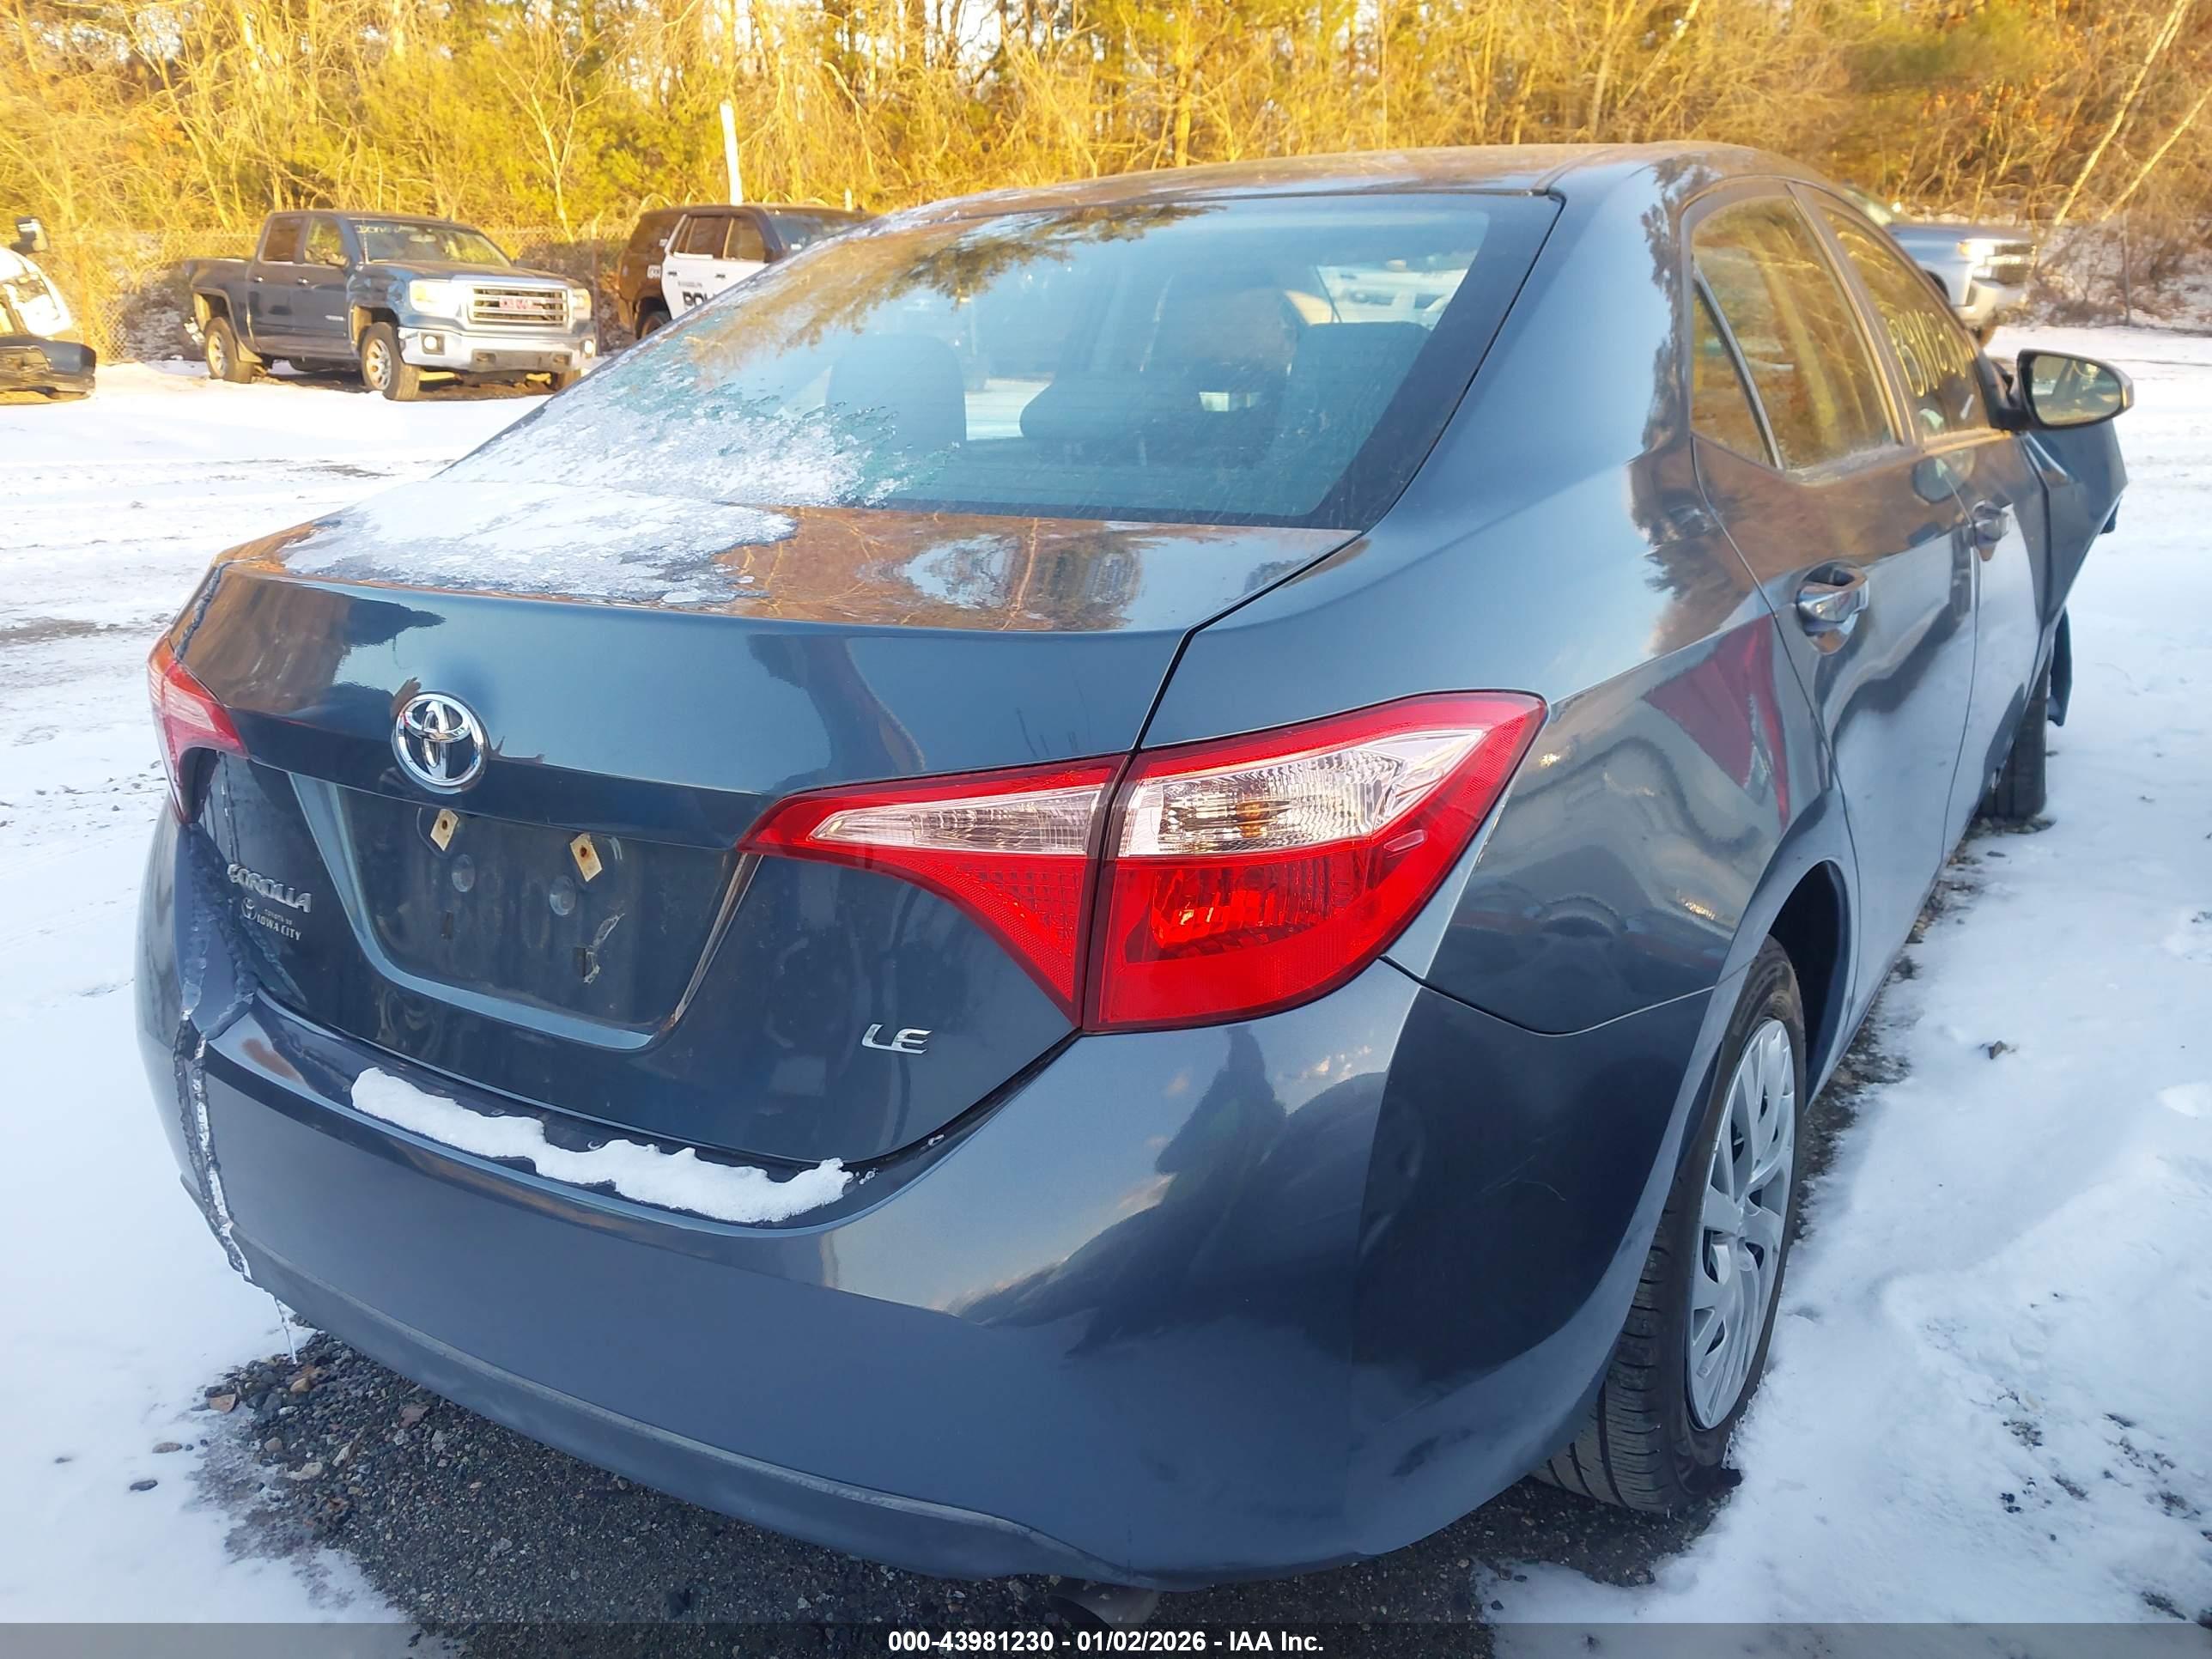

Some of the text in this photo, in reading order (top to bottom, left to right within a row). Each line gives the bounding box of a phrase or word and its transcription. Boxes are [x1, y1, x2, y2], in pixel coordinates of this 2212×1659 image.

[227, 863, 312, 913] COROLLA
[257, 913, 301, 941] IOWA CITY
[861, 1023, 933, 1054] LE
